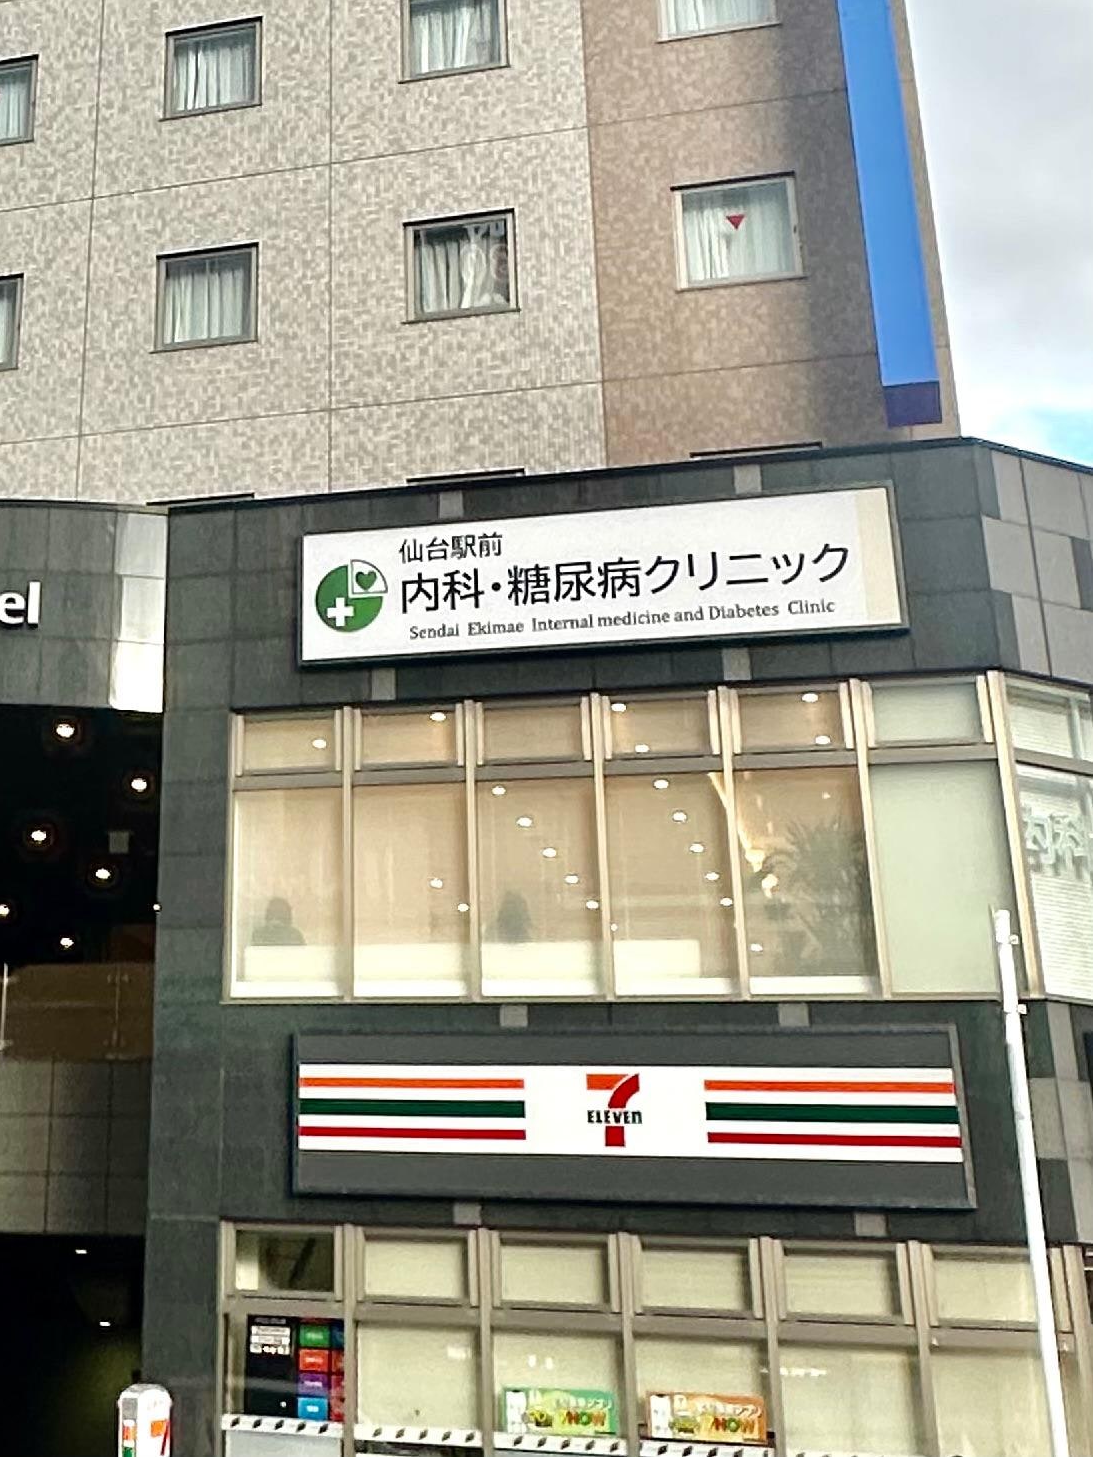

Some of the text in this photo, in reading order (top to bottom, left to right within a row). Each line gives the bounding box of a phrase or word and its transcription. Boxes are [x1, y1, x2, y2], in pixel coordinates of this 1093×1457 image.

[398, 531, 504, 565] 仙台駅前
[401, 543, 849, 614] 内科・糖尿病クリニック
[409, 598, 836, 640] Sendai Ekimae Internal medicine and Diabetes Clinic
